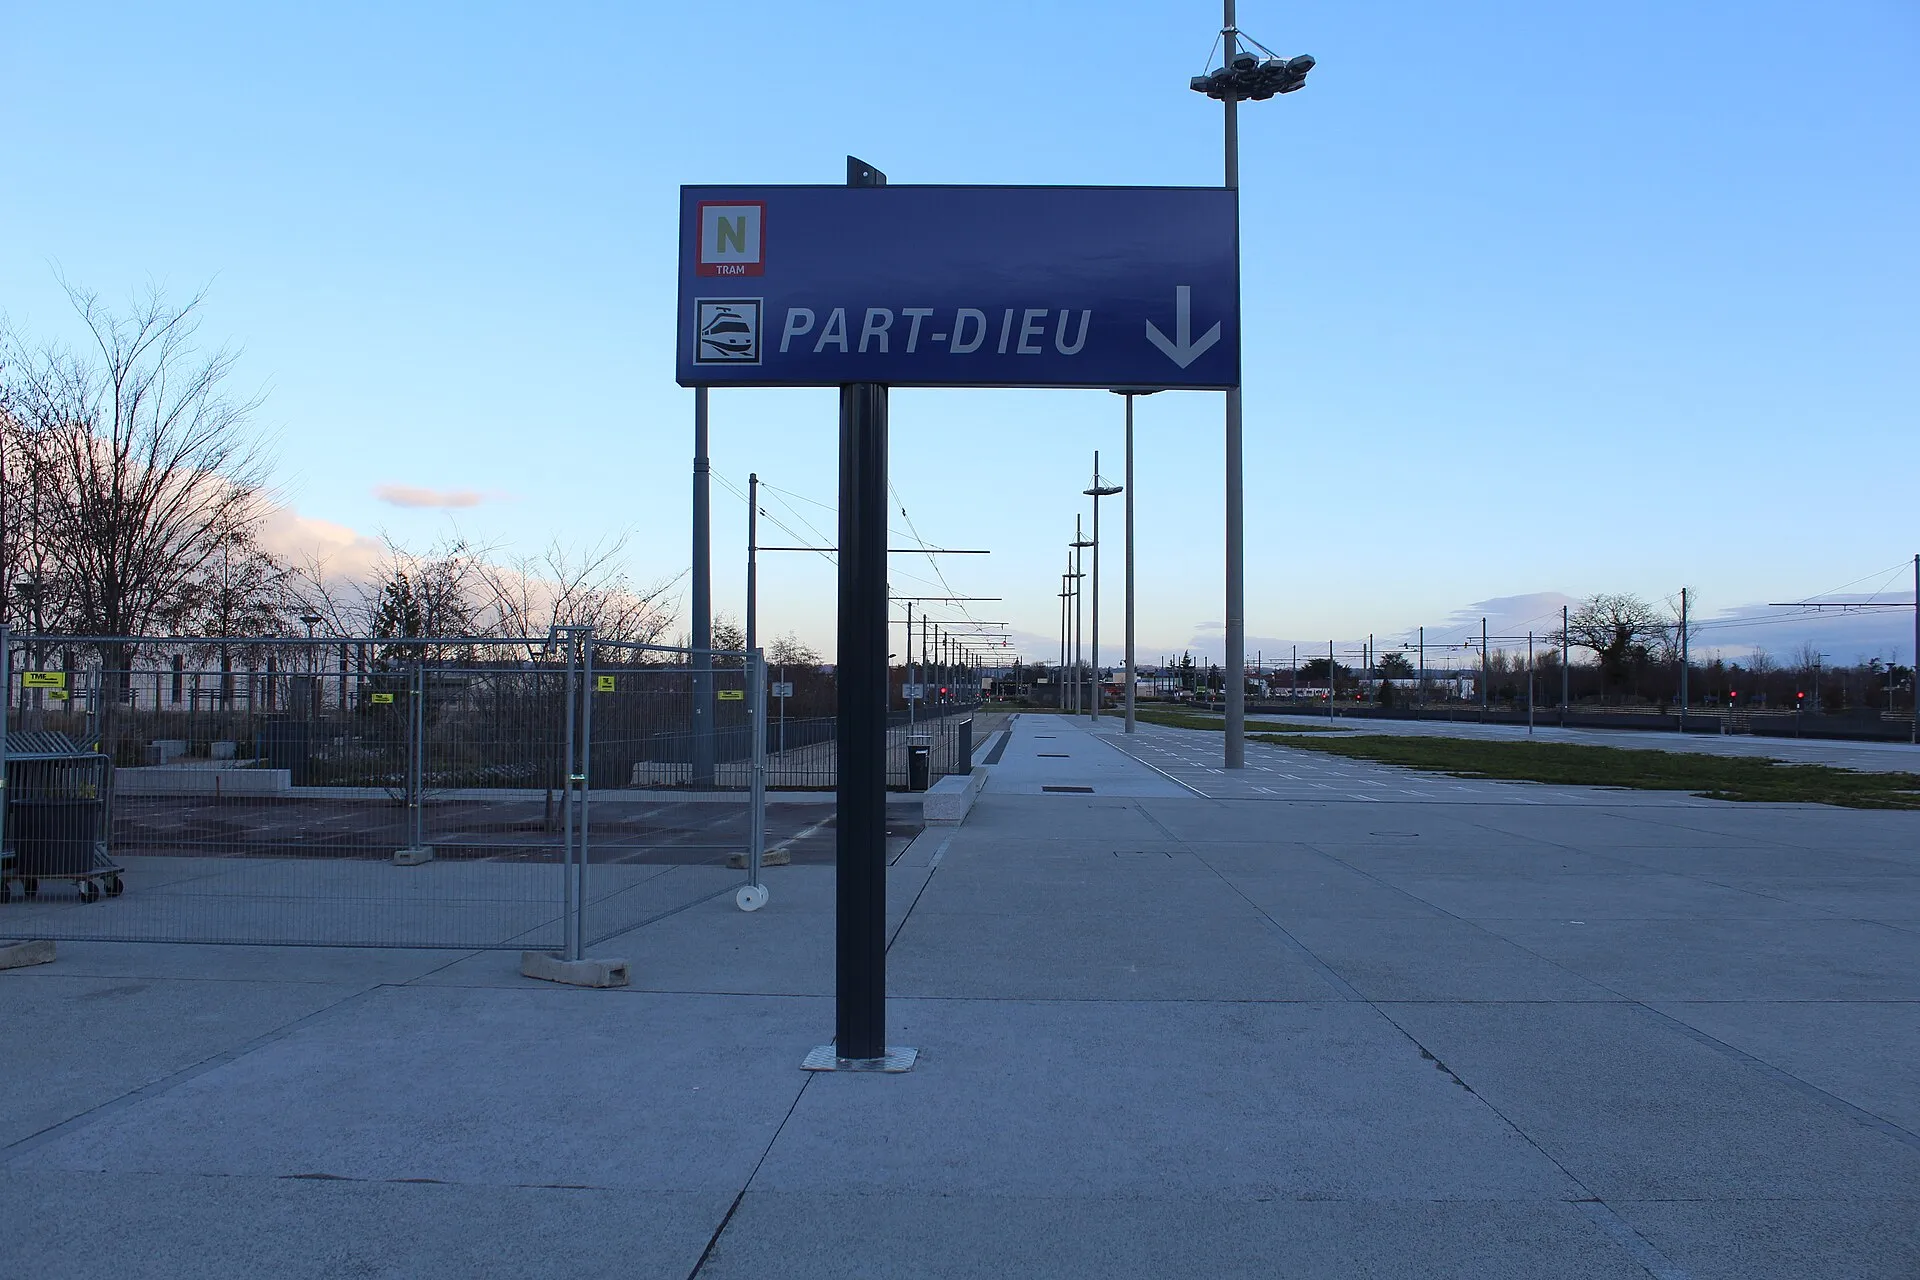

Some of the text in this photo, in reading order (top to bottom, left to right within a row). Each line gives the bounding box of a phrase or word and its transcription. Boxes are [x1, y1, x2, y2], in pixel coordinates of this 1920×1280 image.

[717, 216, 746, 254] N
[716, 265, 745, 275] TRAM
[779, 307, 1092, 355] PART-DIEU
